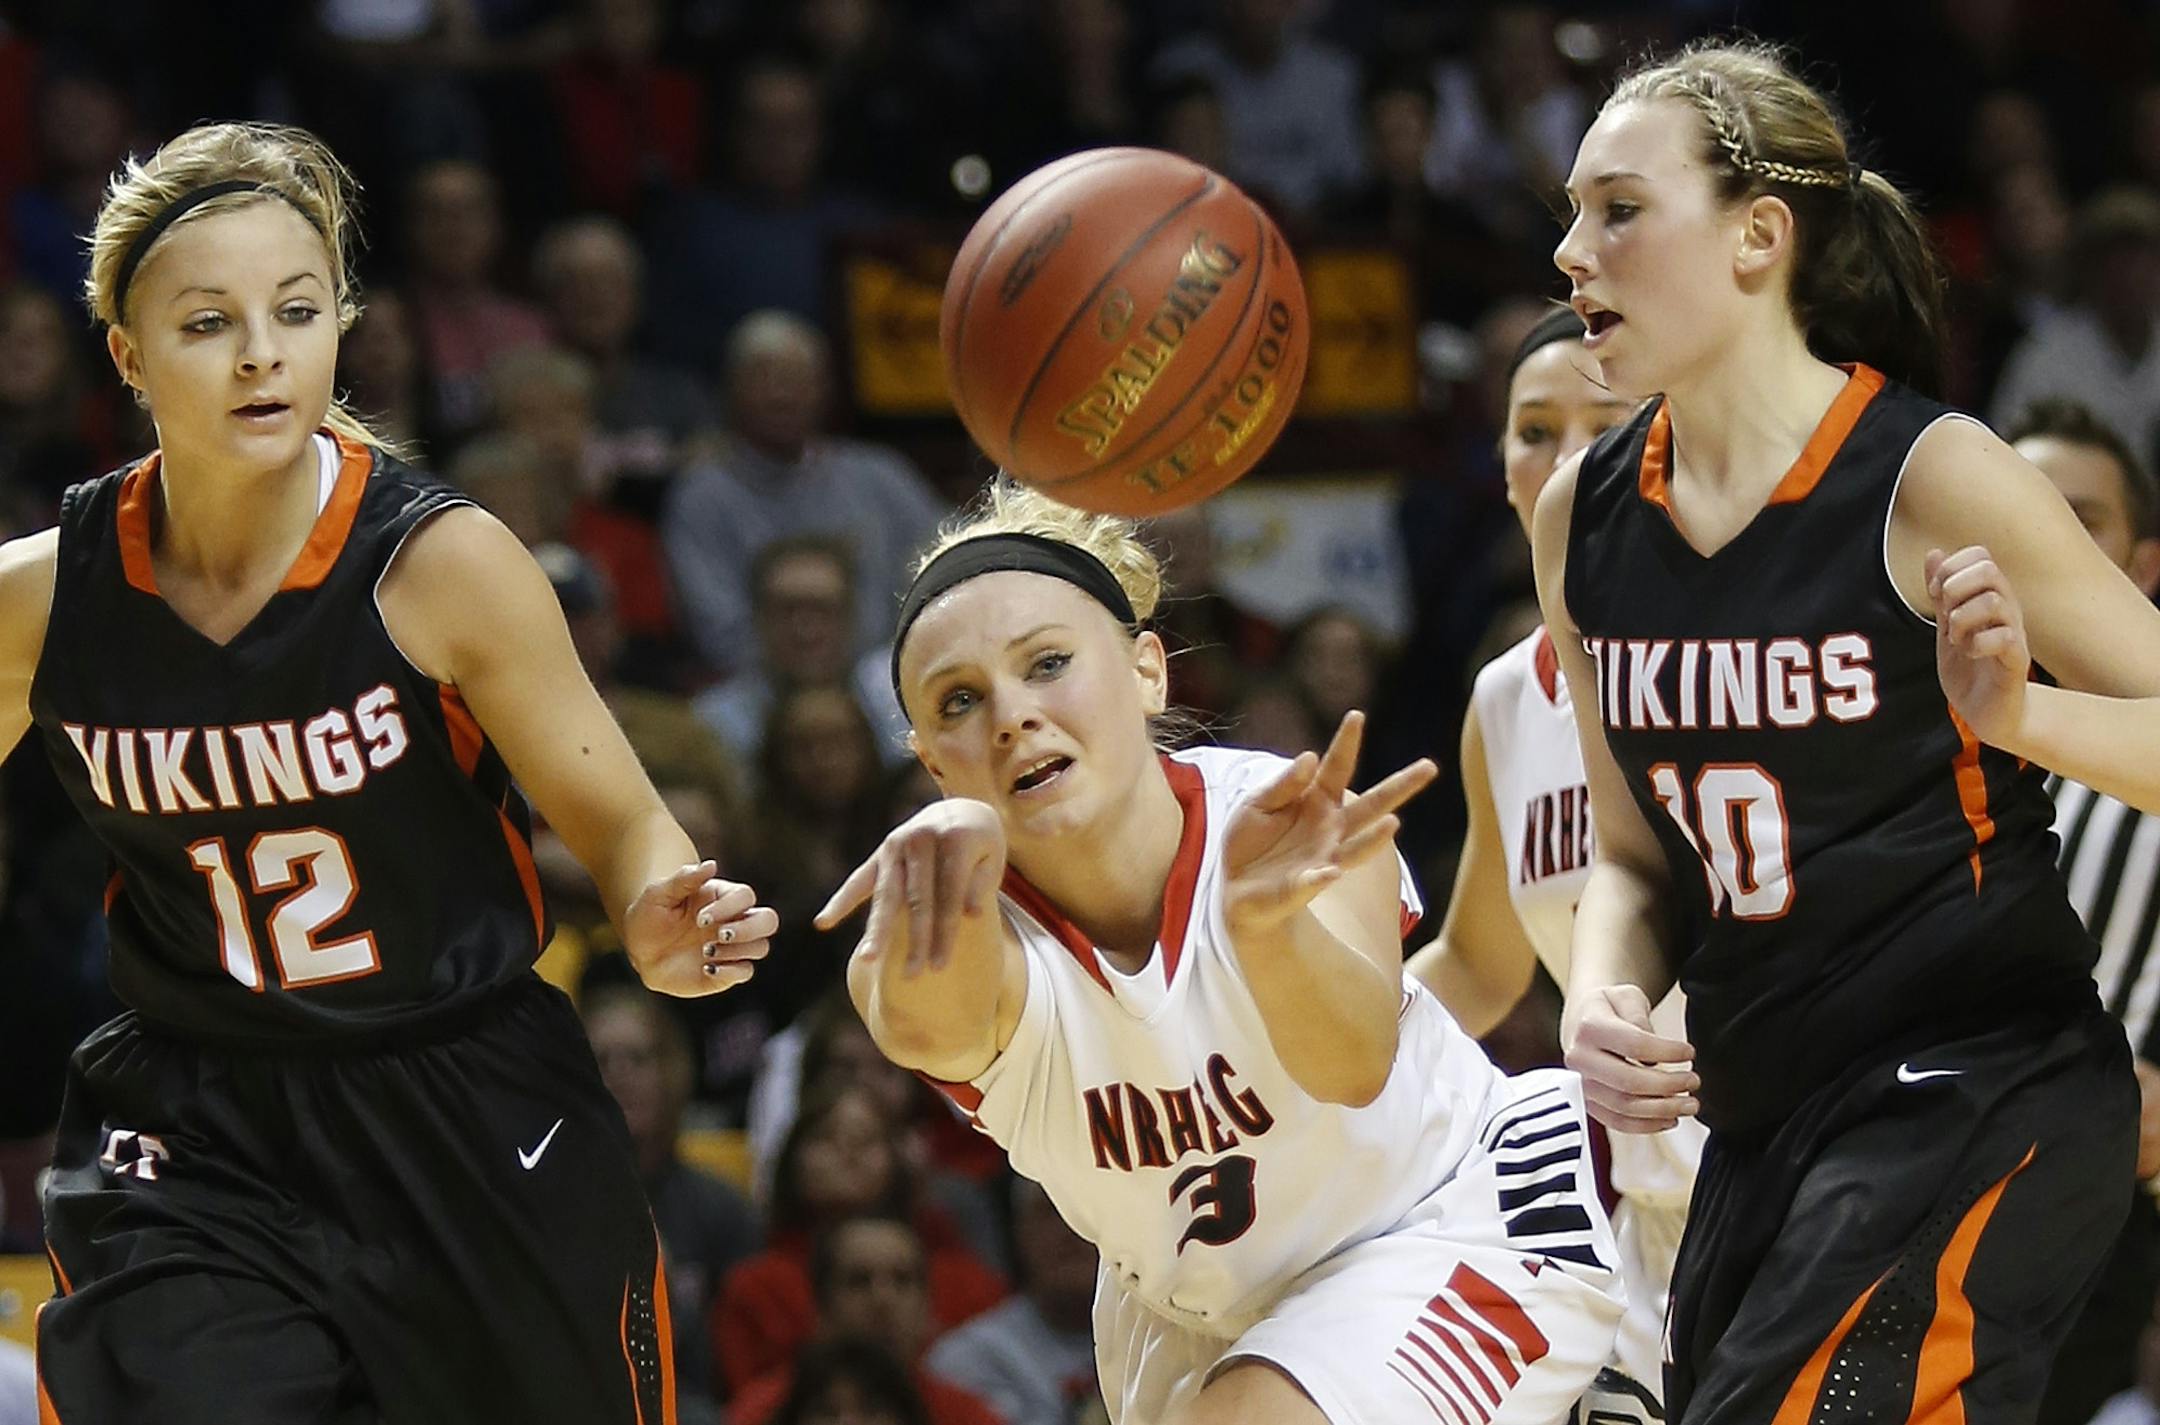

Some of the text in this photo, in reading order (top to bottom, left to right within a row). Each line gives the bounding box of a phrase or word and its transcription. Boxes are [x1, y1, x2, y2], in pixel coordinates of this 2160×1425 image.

[1056, 231, 1241, 459] SPALDING
[1208, 300, 1290, 434] 1000
[63, 682, 409, 814] VIKINGS
[1521, 784, 1594, 885] NRHE
[1648, 761, 1796, 922] 10
[185, 826, 382, 993] 12
[1083, 1053, 1274, 1172] NRHEG
[1168, 1154, 1257, 1258] 3
